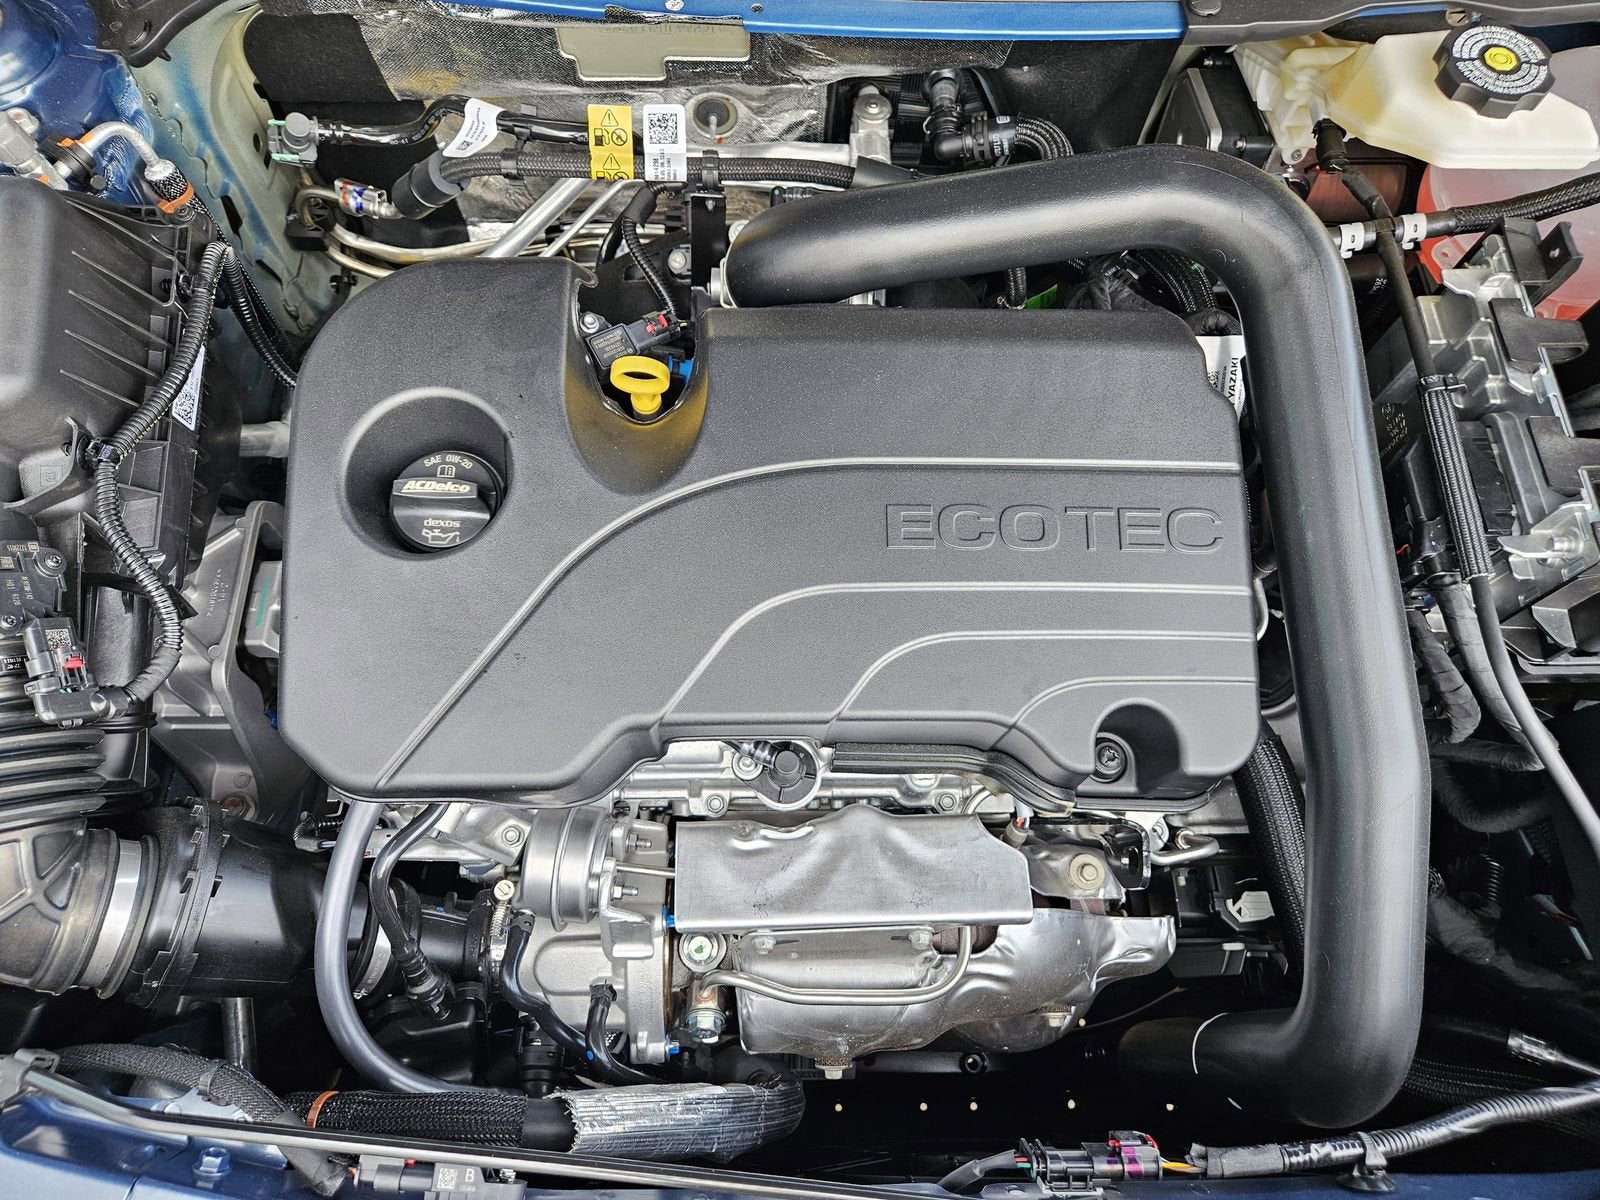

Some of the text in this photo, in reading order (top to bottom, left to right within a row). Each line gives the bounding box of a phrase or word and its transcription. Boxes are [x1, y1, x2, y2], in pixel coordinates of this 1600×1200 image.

[1227, 357, 1239, 399] YAZAKI
[423, 454, 473, 469] SAE 0W-20
[401, 480, 471, 494] ACDelco
[423, 518, 461, 528] dexos
[885, 503, 1224, 555] ECOTEC
[465, 1168, 475, 1183] B
